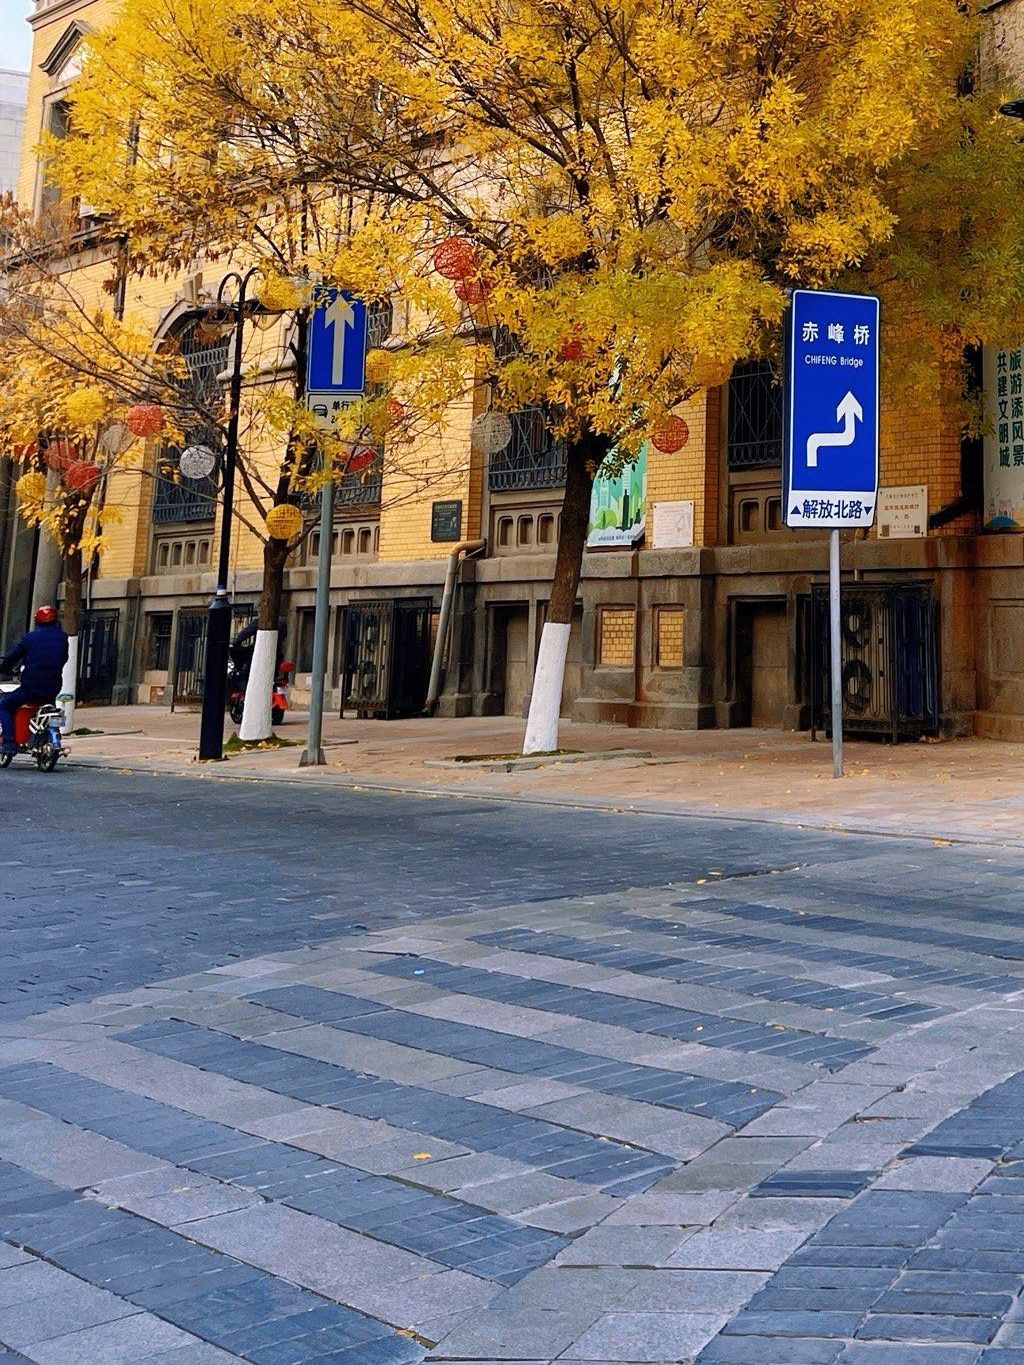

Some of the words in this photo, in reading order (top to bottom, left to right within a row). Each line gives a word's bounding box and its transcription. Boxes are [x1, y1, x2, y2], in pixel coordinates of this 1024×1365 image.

[802, 321, 870, 345] 赤峰桥
[804, 354, 838, 366] CHIFENG
[840, 356, 864, 369] Bridge
[997, 351, 1011, 468] 共建文明城
[802, 499, 863, 519] 解放北路
